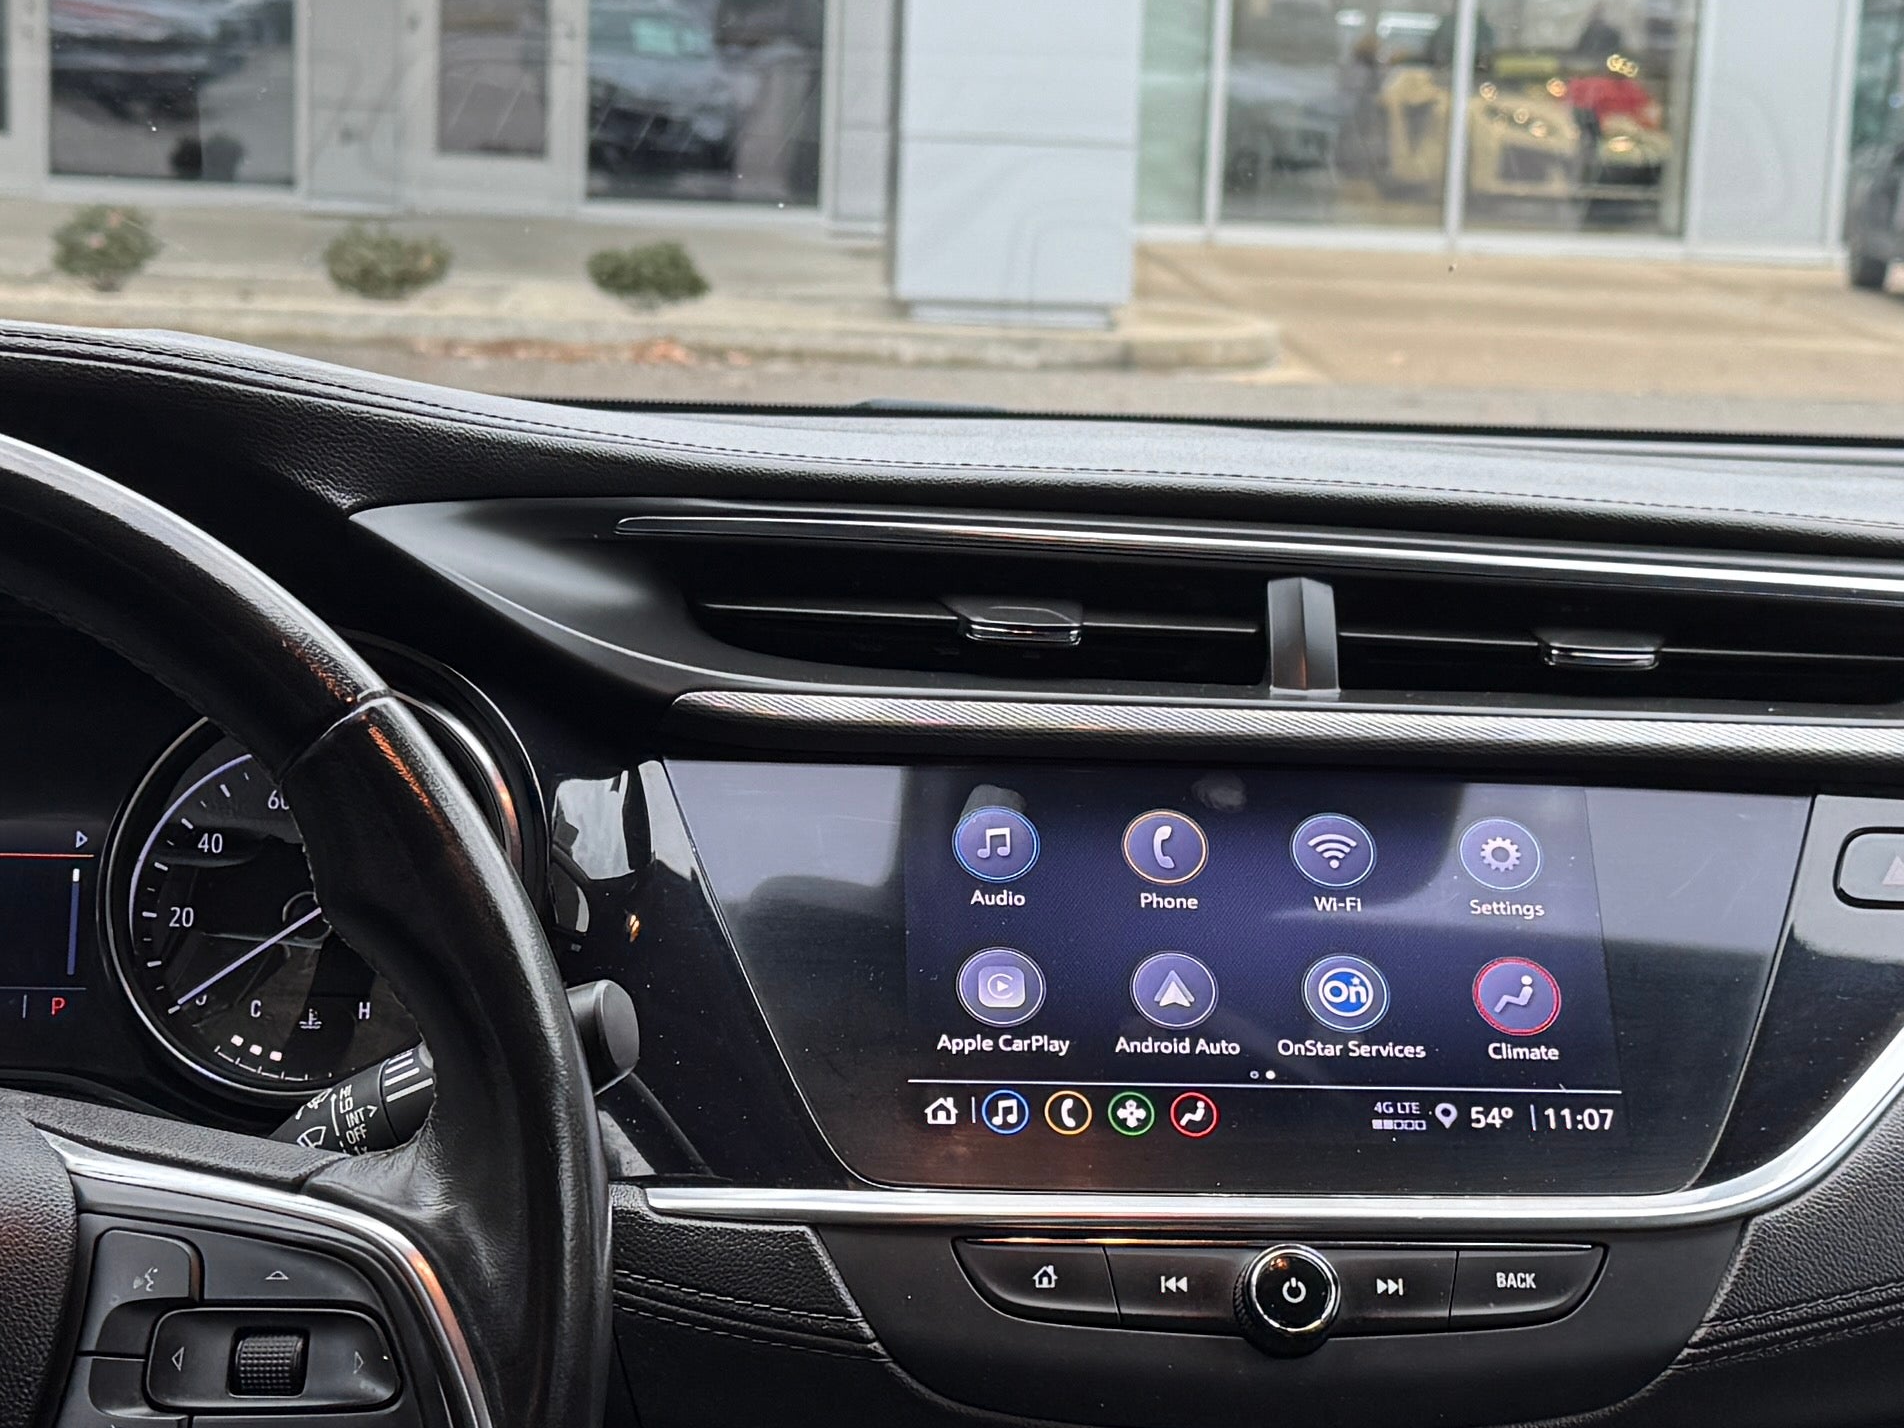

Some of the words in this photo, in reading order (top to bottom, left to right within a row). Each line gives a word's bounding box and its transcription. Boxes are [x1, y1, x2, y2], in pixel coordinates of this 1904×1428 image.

[197, 833, 223, 854] 40
[969, 888, 1026, 907] Audio
[1139, 892, 1199, 911] Phone
[1313, 895, 1363, 913] Wi-Fi
[169, 906, 195, 928] 20
[1469, 898, 1546, 920] Settings
[51, 997, 66, 1016] P
[250, 999, 262, 1019] C
[358, 1001, 371, 1020] H
[937, 1035, 995, 1056] Apple
[998, 1035, 1071, 1057] CarPlay
[1114, 1036, 1191, 1056] Android
[1195, 1038, 1241, 1056] Auto
[1277, 1039, 1346, 1058] OnStar
[1350, 1041, 1427, 1060] Services
[1487, 1042, 1560, 1061] Climate
[339, 1083, 353, 1100] HI
[339, 1097, 354, 1114] LO
[1373, 1101, 1394, 1115] 4G
[1396, 1102, 1420, 1115] LTE
[1544, 1107, 1614, 1130] 11:07
[345, 1106, 365, 1129] INT
[346, 1123, 367, 1145] OFF
[1496, 1270, 1537, 1291] BACK
